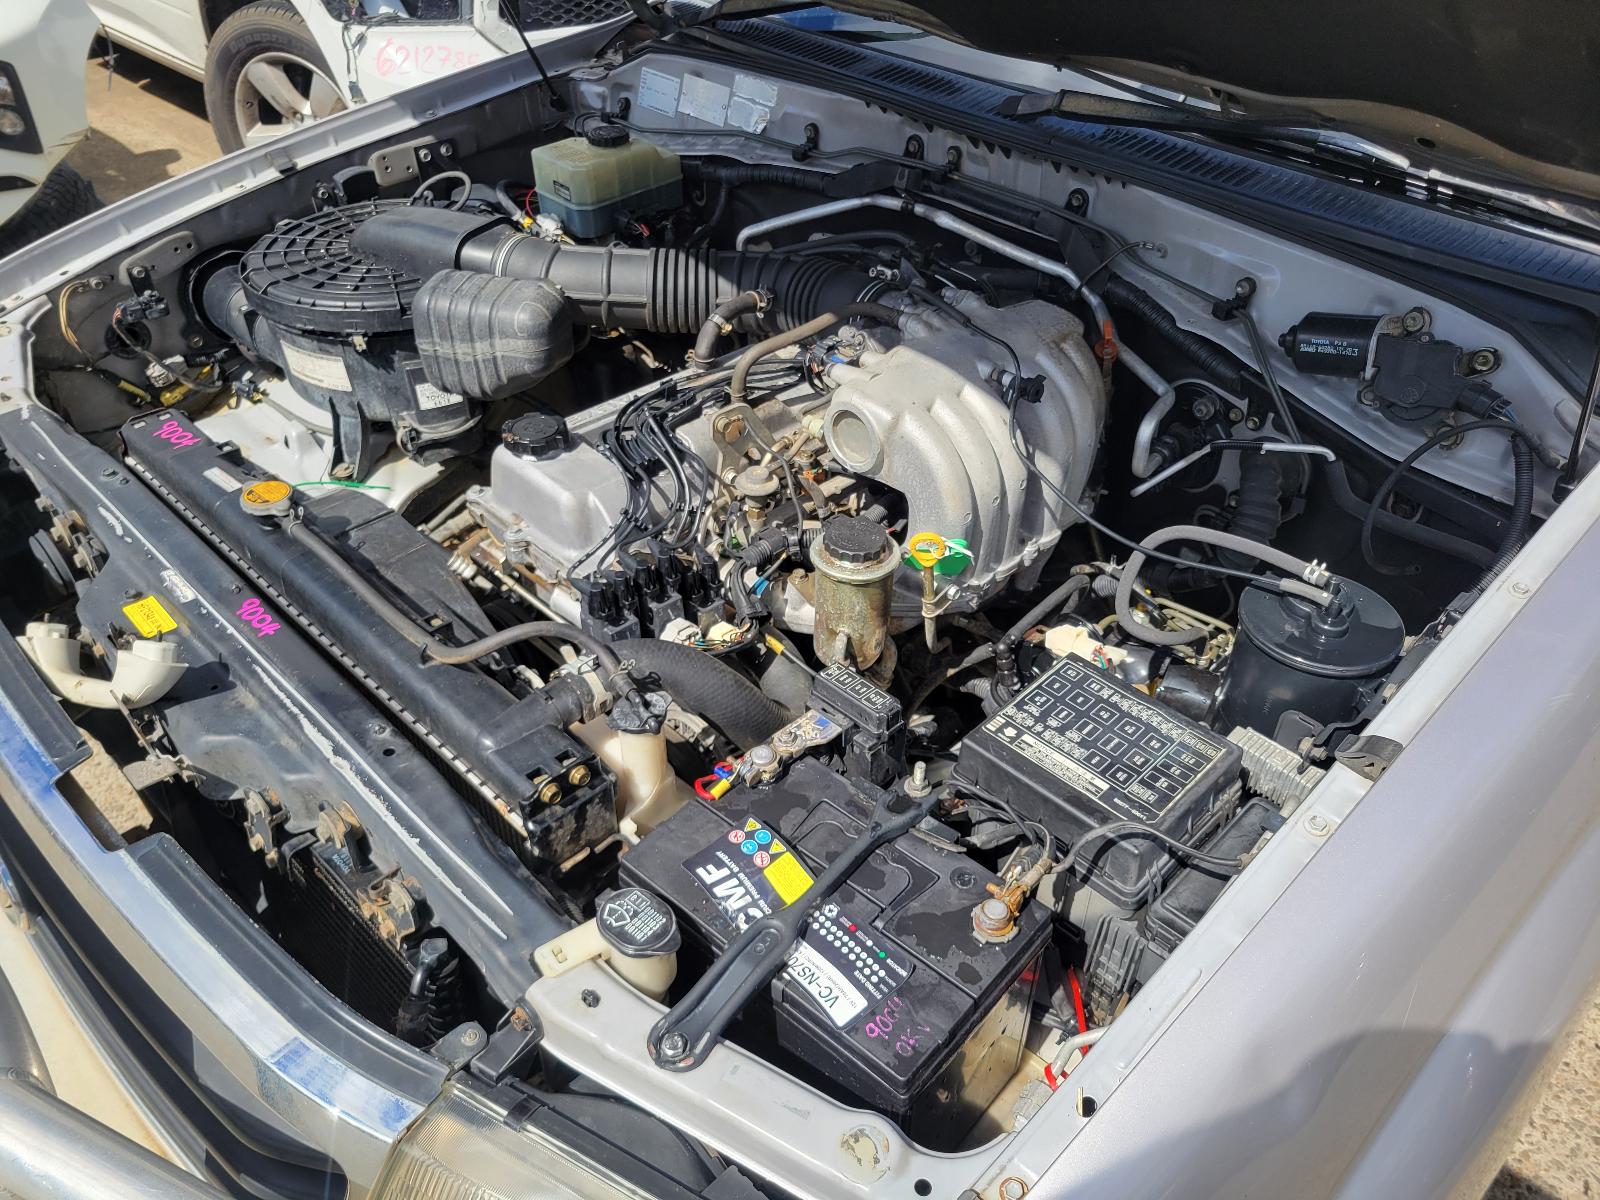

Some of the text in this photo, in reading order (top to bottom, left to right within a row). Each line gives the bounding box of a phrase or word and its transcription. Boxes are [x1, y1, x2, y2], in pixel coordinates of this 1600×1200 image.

[236, 597, 281, 638] 9004
[715, 850, 740, 873] BATTERY
[737, 872, 761, 899] PREMIUM
[853, 969, 883, 999] FITTING DATE
